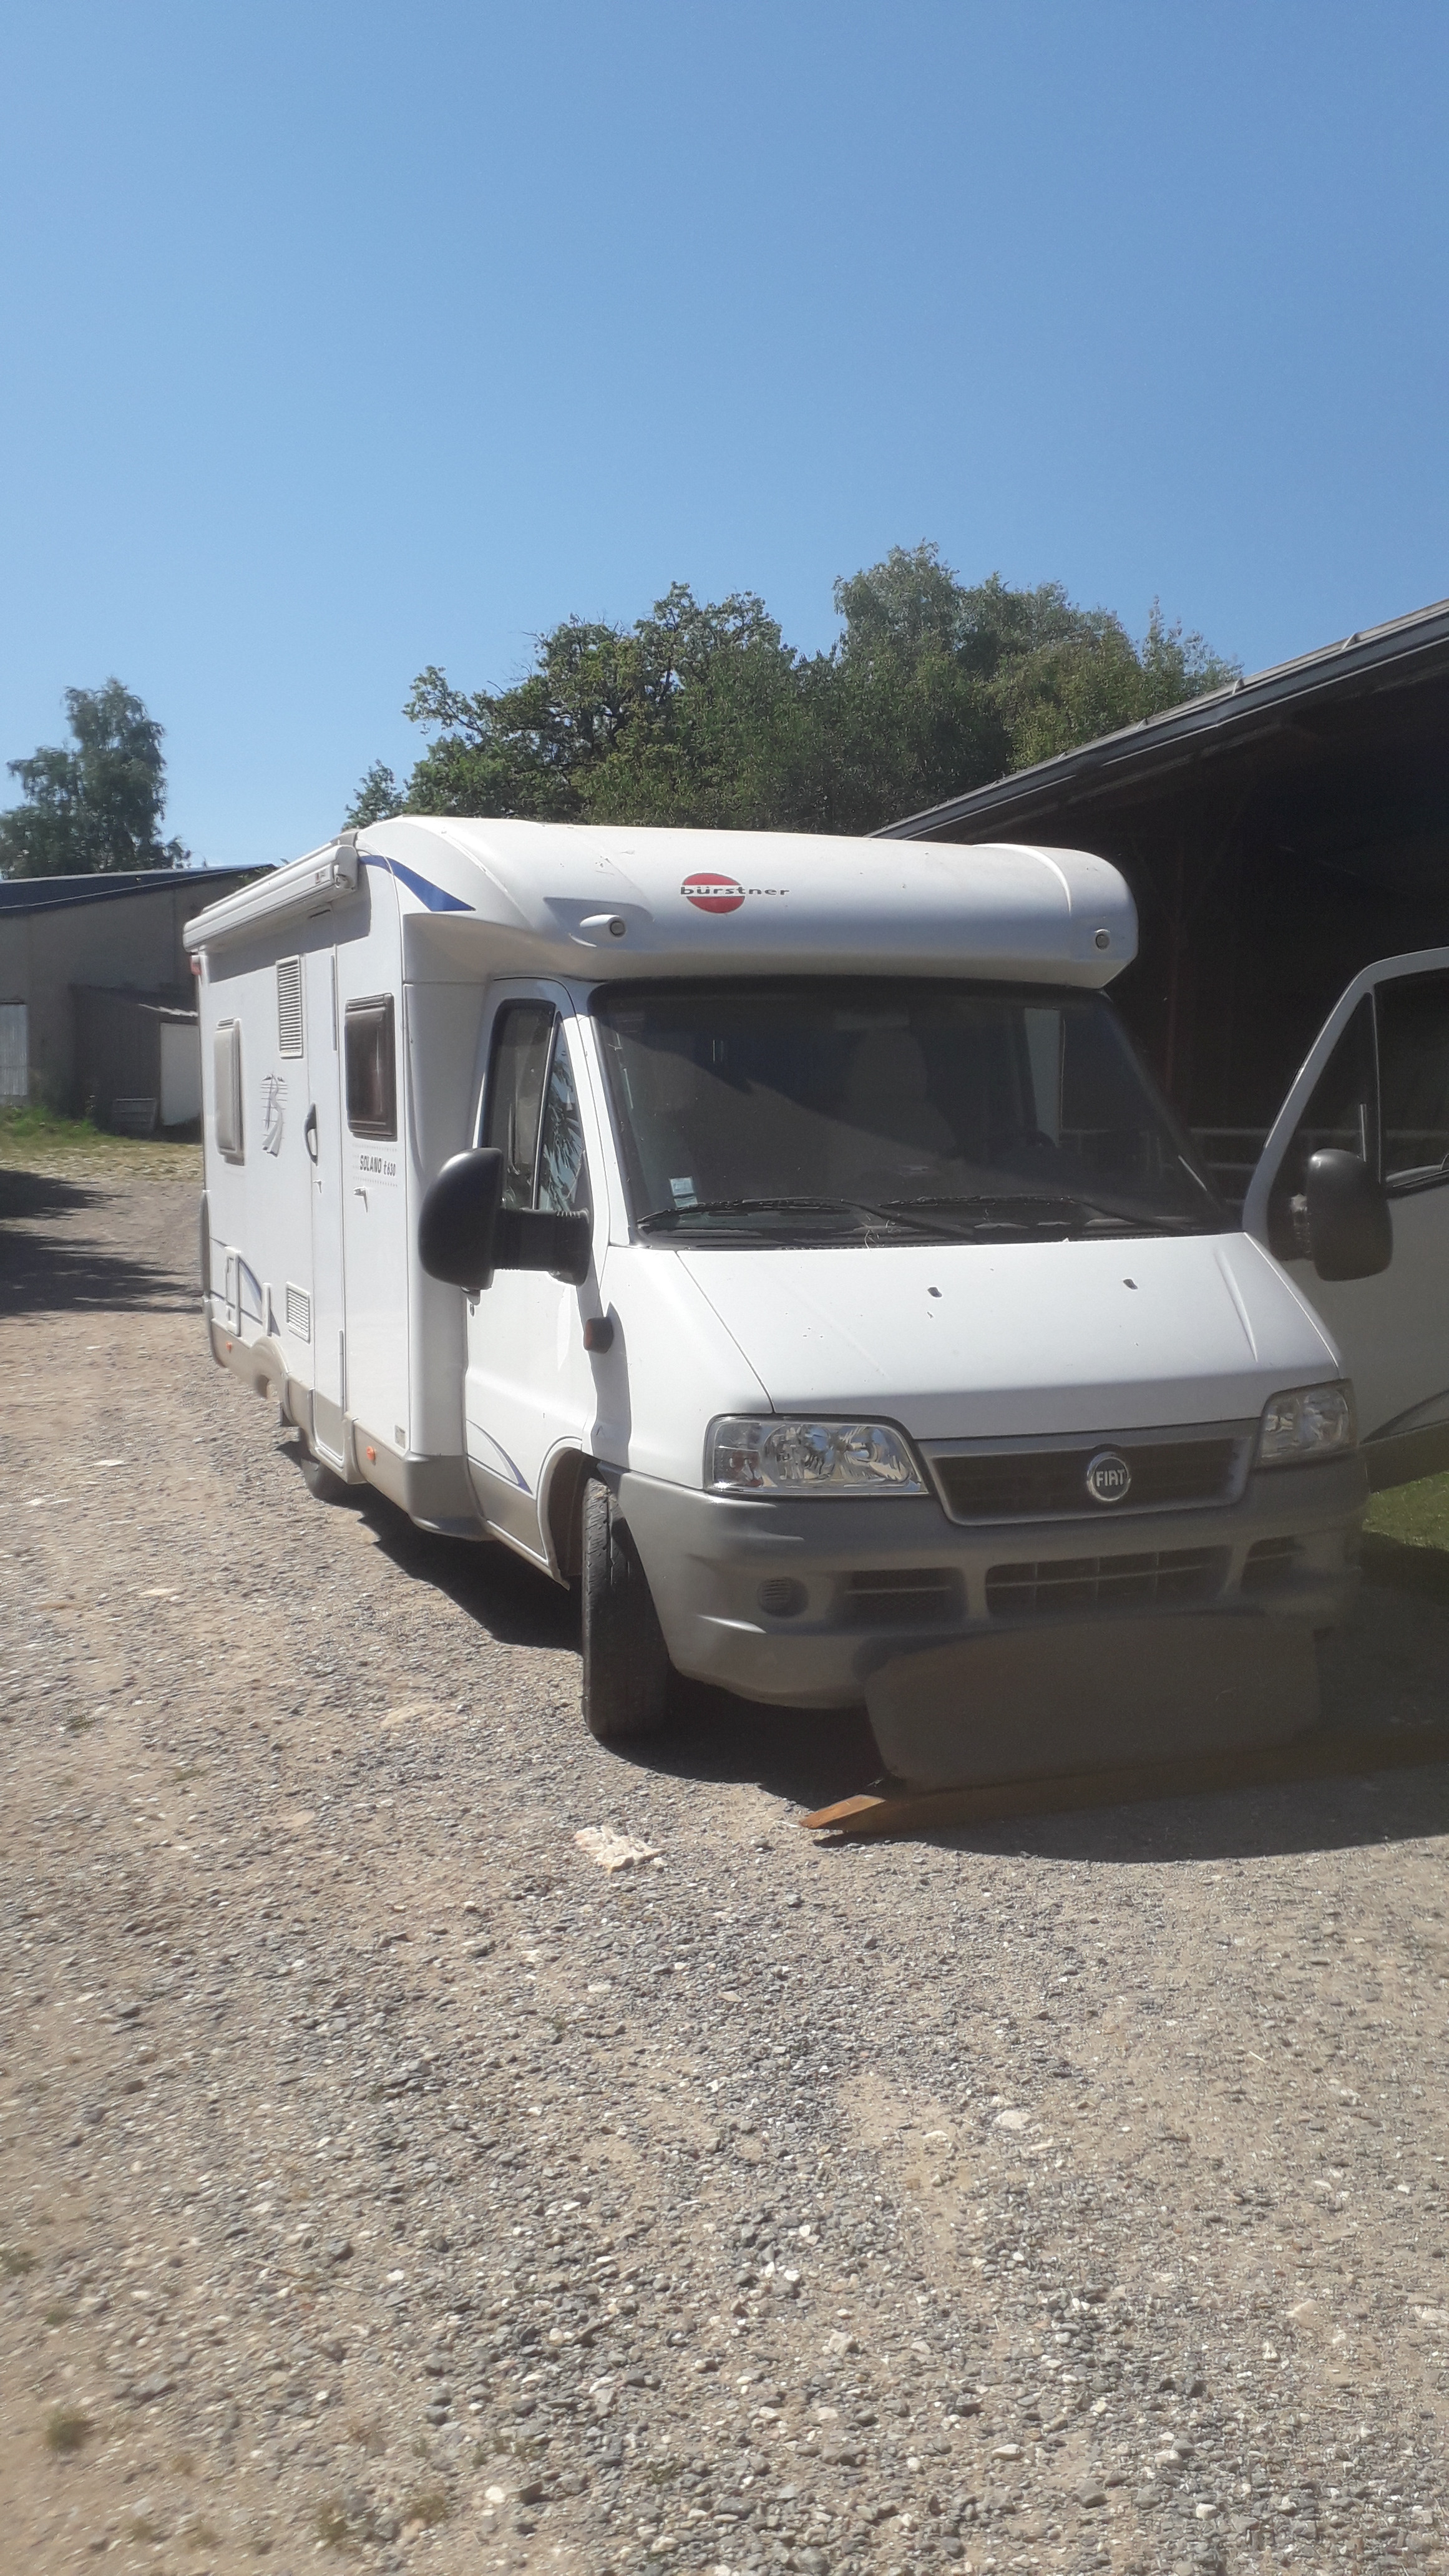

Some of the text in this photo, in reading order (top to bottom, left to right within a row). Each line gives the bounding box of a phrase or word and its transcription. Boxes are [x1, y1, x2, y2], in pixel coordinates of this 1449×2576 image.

[680, 886, 790, 895] bürstner
[359, 1154, 382, 1174] SOLANO
[1096, 1469, 1125, 1486] FIAT
